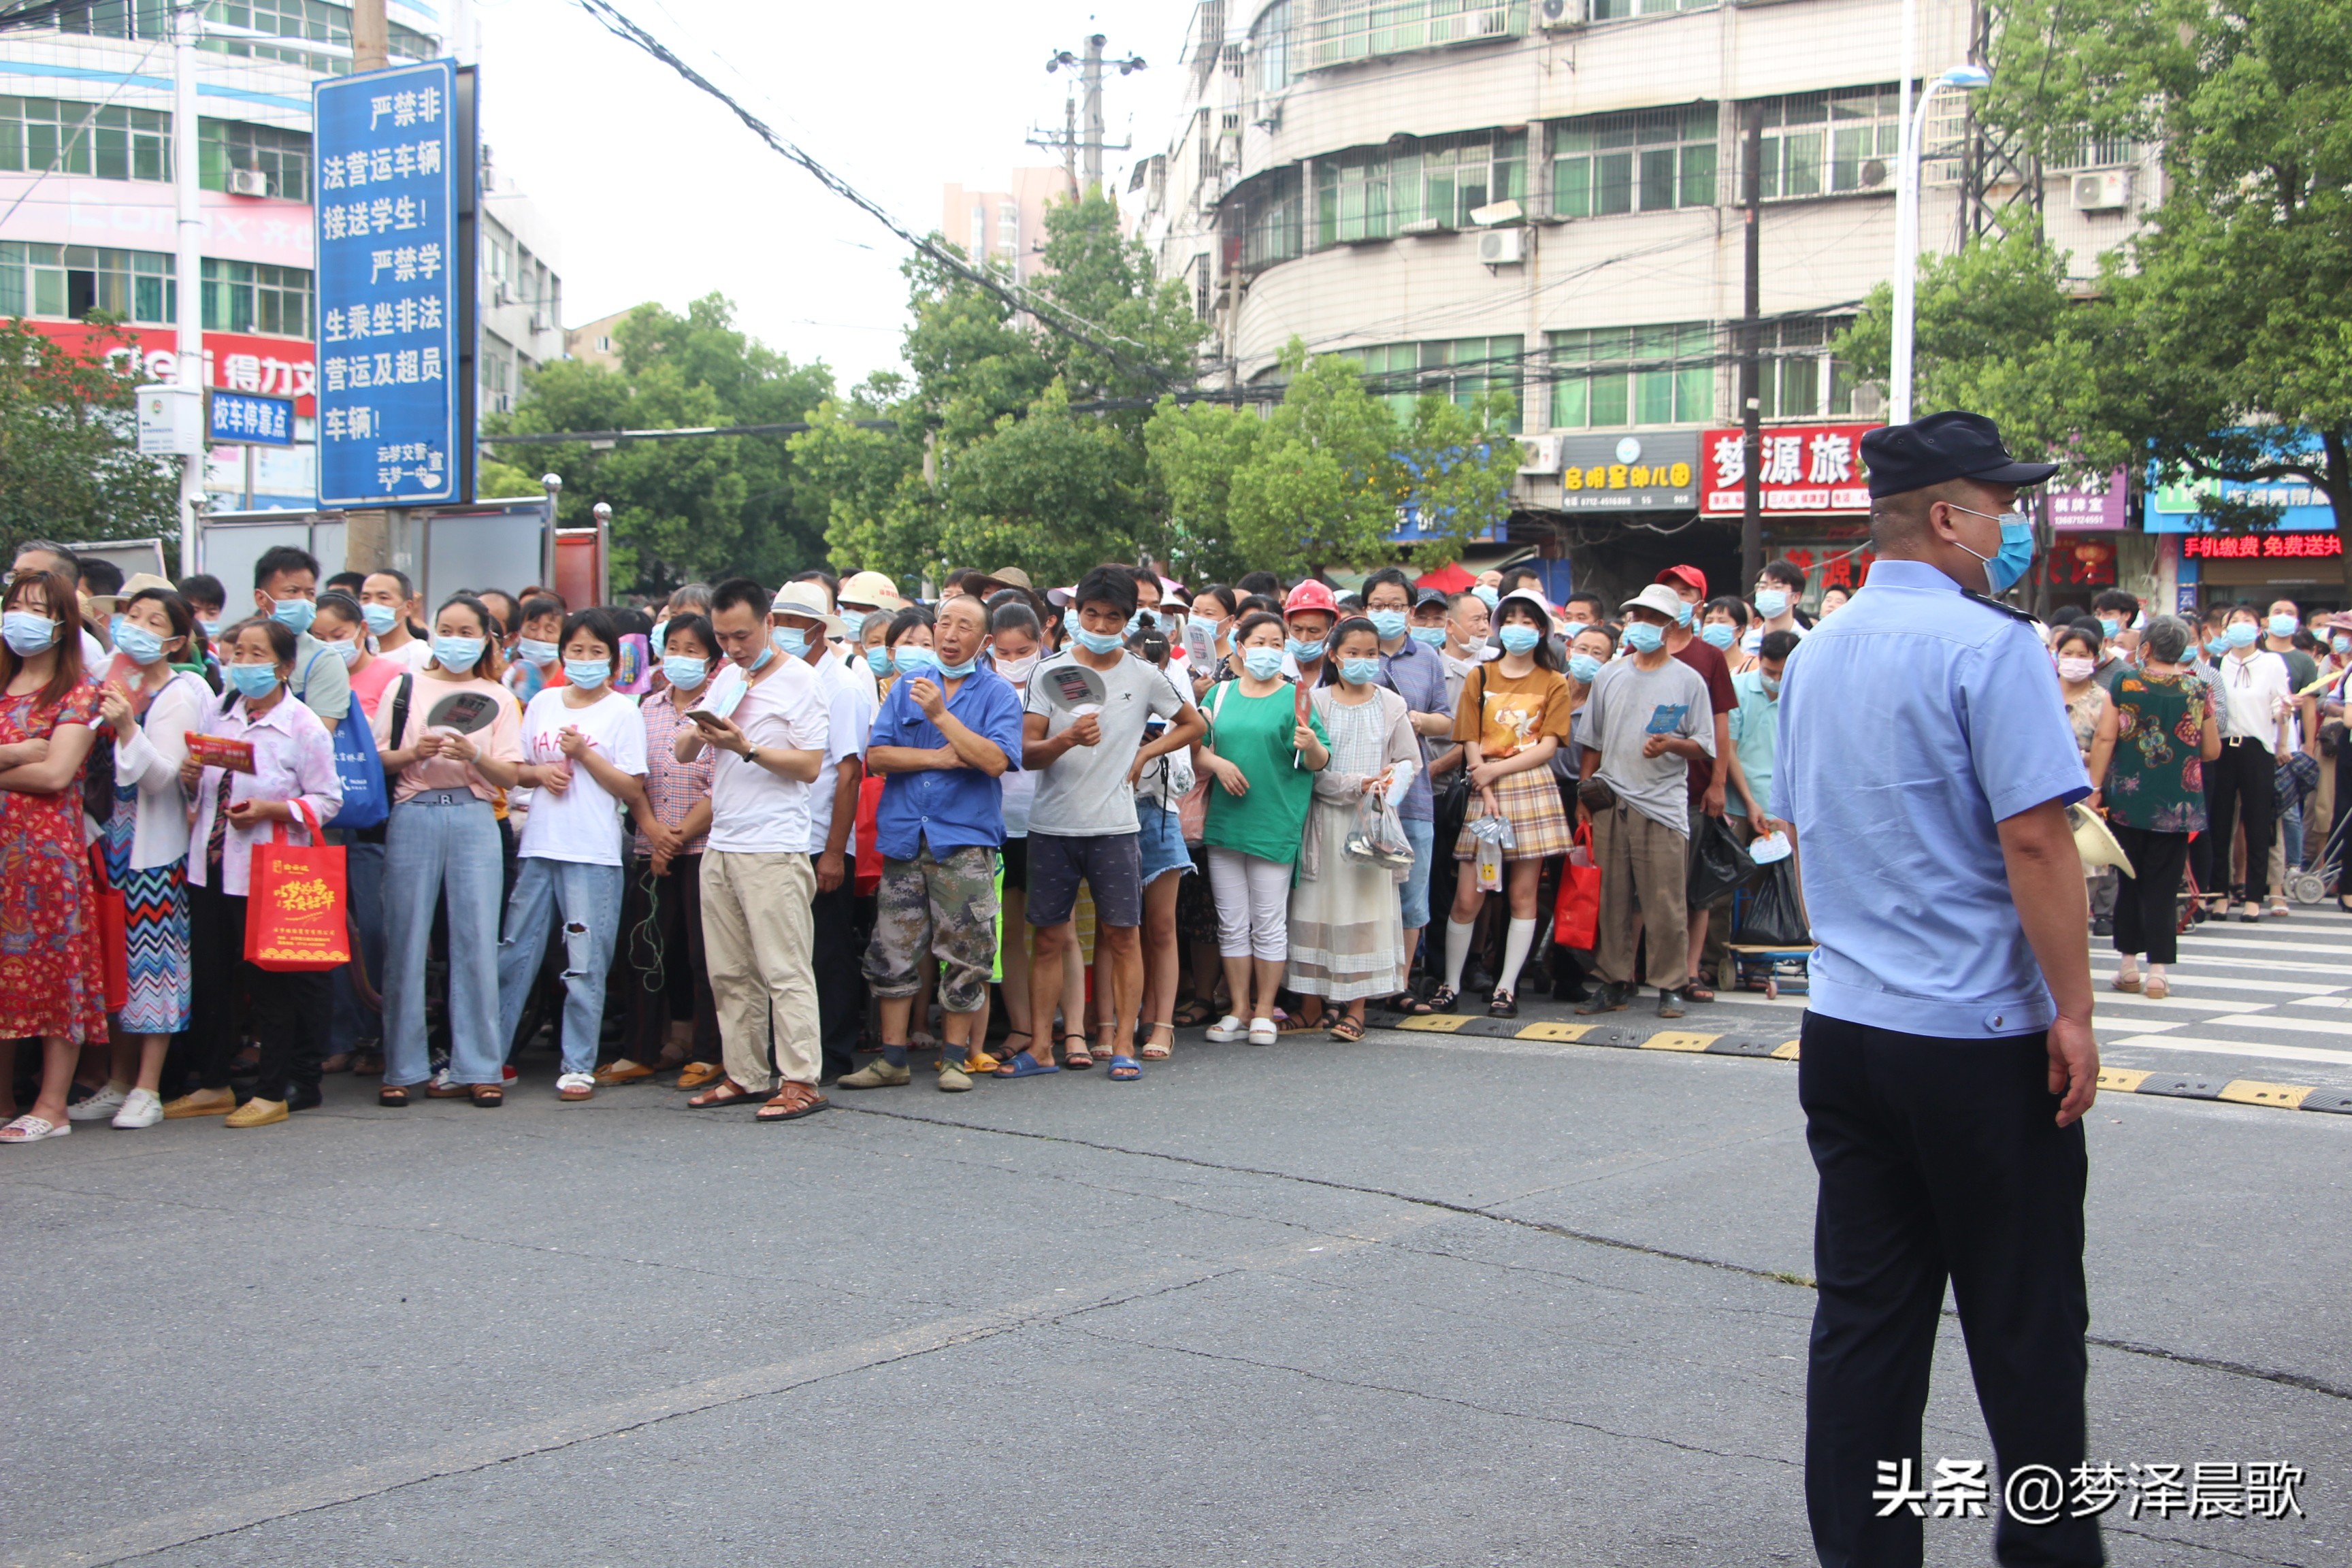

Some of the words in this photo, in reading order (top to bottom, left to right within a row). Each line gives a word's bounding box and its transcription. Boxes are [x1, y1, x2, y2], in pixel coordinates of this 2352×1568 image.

[370, 86, 441, 131] 严禁非
[323, 140, 441, 190] 法营运车辆
[370, 243, 441, 285] 严禁学
[325, 295, 442, 342] 生乘坐非法
[105, 346, 214, 387] dei
[325, 346, 442, 392] 营运及超员
[214, 396, 287, 438] 校车停靠点
[377, 443, 427, 463] 云梦交警
[1712, 431, 1872, 489] 梦源旅
[1565, 462, 1691, 491] 启明星幼儿园
[2054, 497, 2104, 513] 棋牌室
[2185, 535, 2259, 557] 手机缴费
